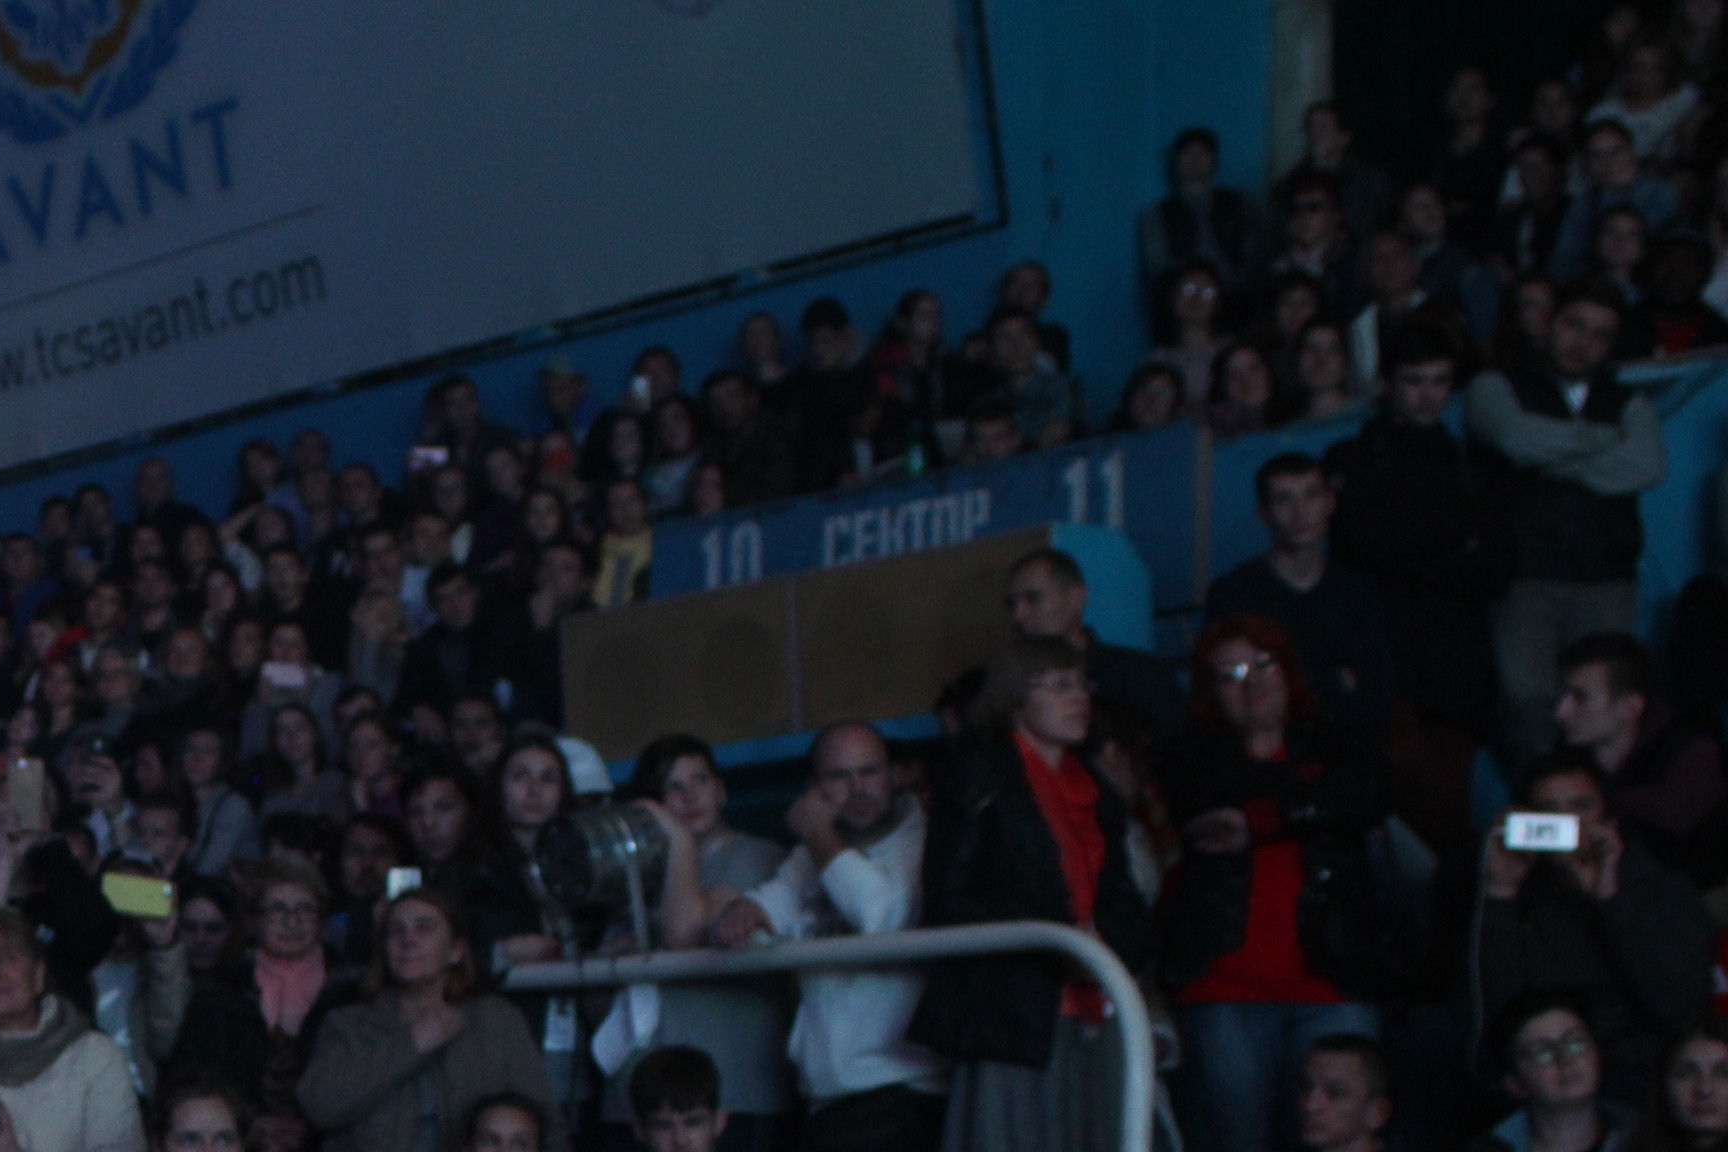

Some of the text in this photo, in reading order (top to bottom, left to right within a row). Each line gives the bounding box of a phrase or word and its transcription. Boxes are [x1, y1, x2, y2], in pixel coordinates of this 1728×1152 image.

[701, 449, 1125, 590] 10 СЕКТОР 11
